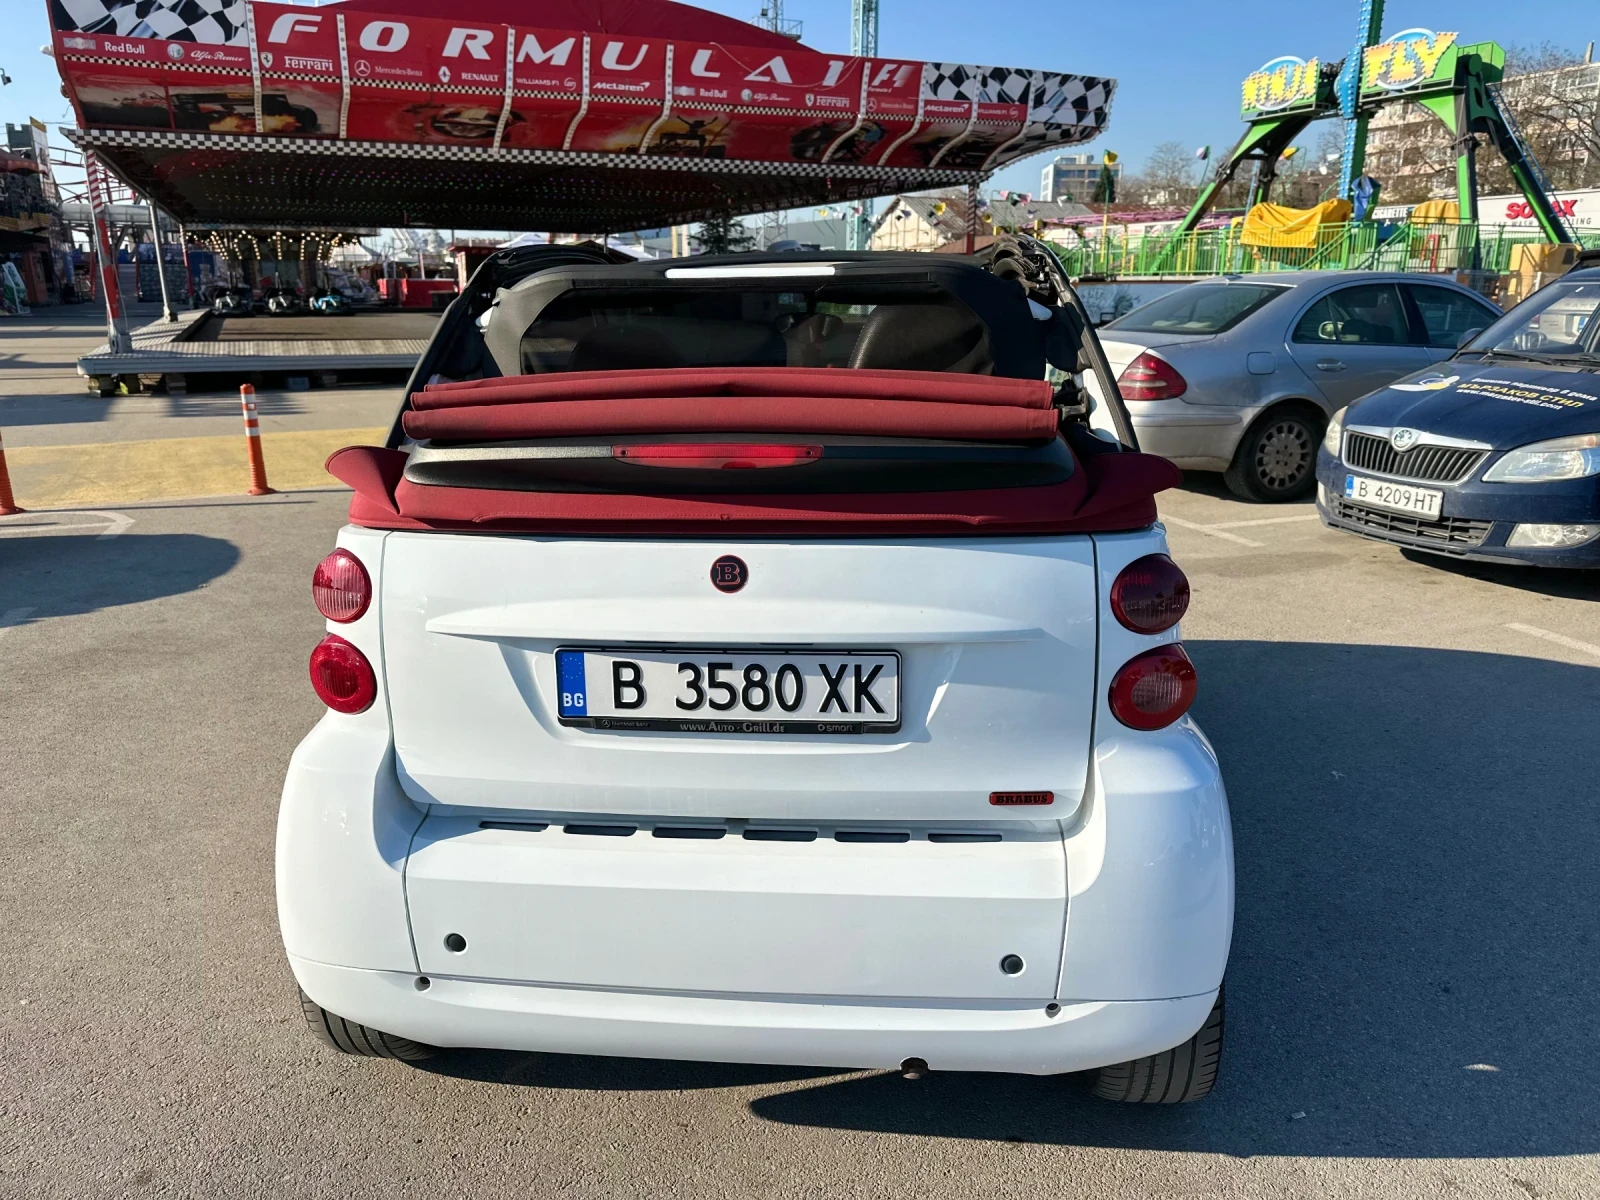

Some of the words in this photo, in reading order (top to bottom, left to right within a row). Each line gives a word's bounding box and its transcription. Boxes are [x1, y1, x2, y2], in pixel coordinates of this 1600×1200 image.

[104, 41, 125, 54] Red
[125, 42, 145, 55] Bull
[284, 55, 333, 72] Ferrari
[1362, 31, 1459, 89] FLY
[374, 66, 424, 77] Mercedes-Benz
[461, 71, 500, 83] RENAULT
[592, 81, 645, 92] McLaren
[699, 88, 713, 98] Red
[713, 89, 728, 99] Bull
[816, 95, 850, 108] Ferrari
[923, 104, 965, 113] McLaren
[1505, 199, 1578, 220] SOAX
[1457, 383, 1540, 399] МЪРЗАКОВ
[1540, 394, 1585, 408] СТИЛ
[1358, 481, 1369, 498] B
[1375, 486, 1412, 507] 4209
[1413, 491, 1438, 512] HT
[612, 660, 646, 710] B
[674, 661, 805, 713] 3580
[817, 663, 886, 714] XK
[562, 692, 585, 707] BG
[825, 724, 855, 732] smart
[995, 794, 1049, 804] BRABUS
